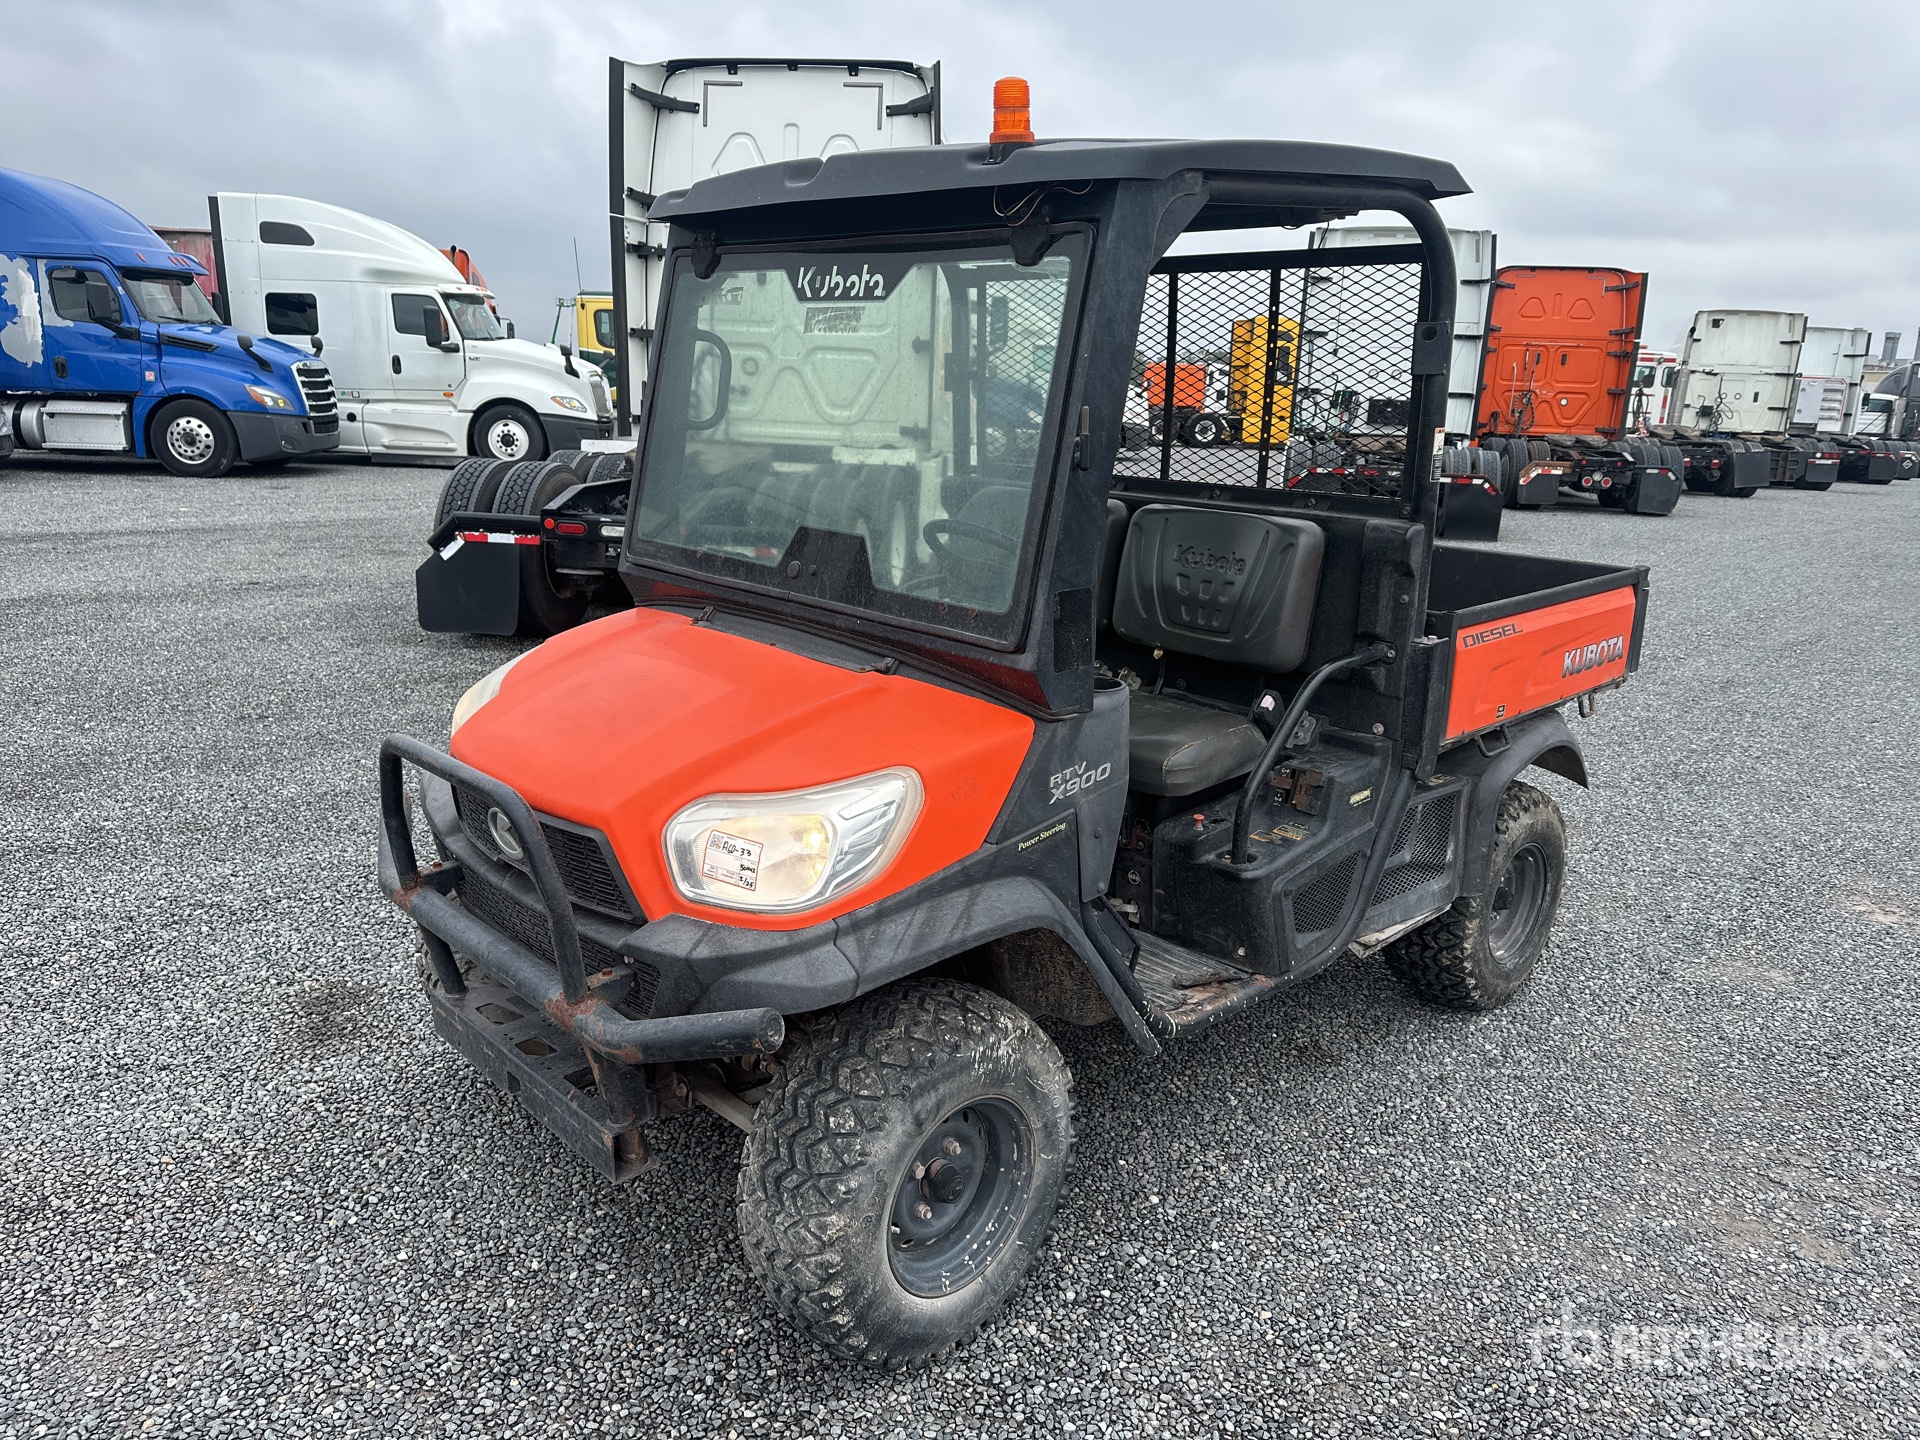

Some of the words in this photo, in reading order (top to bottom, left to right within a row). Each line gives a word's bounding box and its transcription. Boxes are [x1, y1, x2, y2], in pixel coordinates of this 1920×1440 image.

[797, 264, 884, 298] Kubota
[1173, 544, 1246, 576] Kubota
[1462, 623, 1524, 649] DIESEL
[1561, 635, 1624, 678] KUBOTA
[1048, 762, 1112, 805] X900
[1050, 761, 1087, 788] RTV
[1017, 836, 1040, 852] Power
[1039, 822, 1067, 841] Steering
